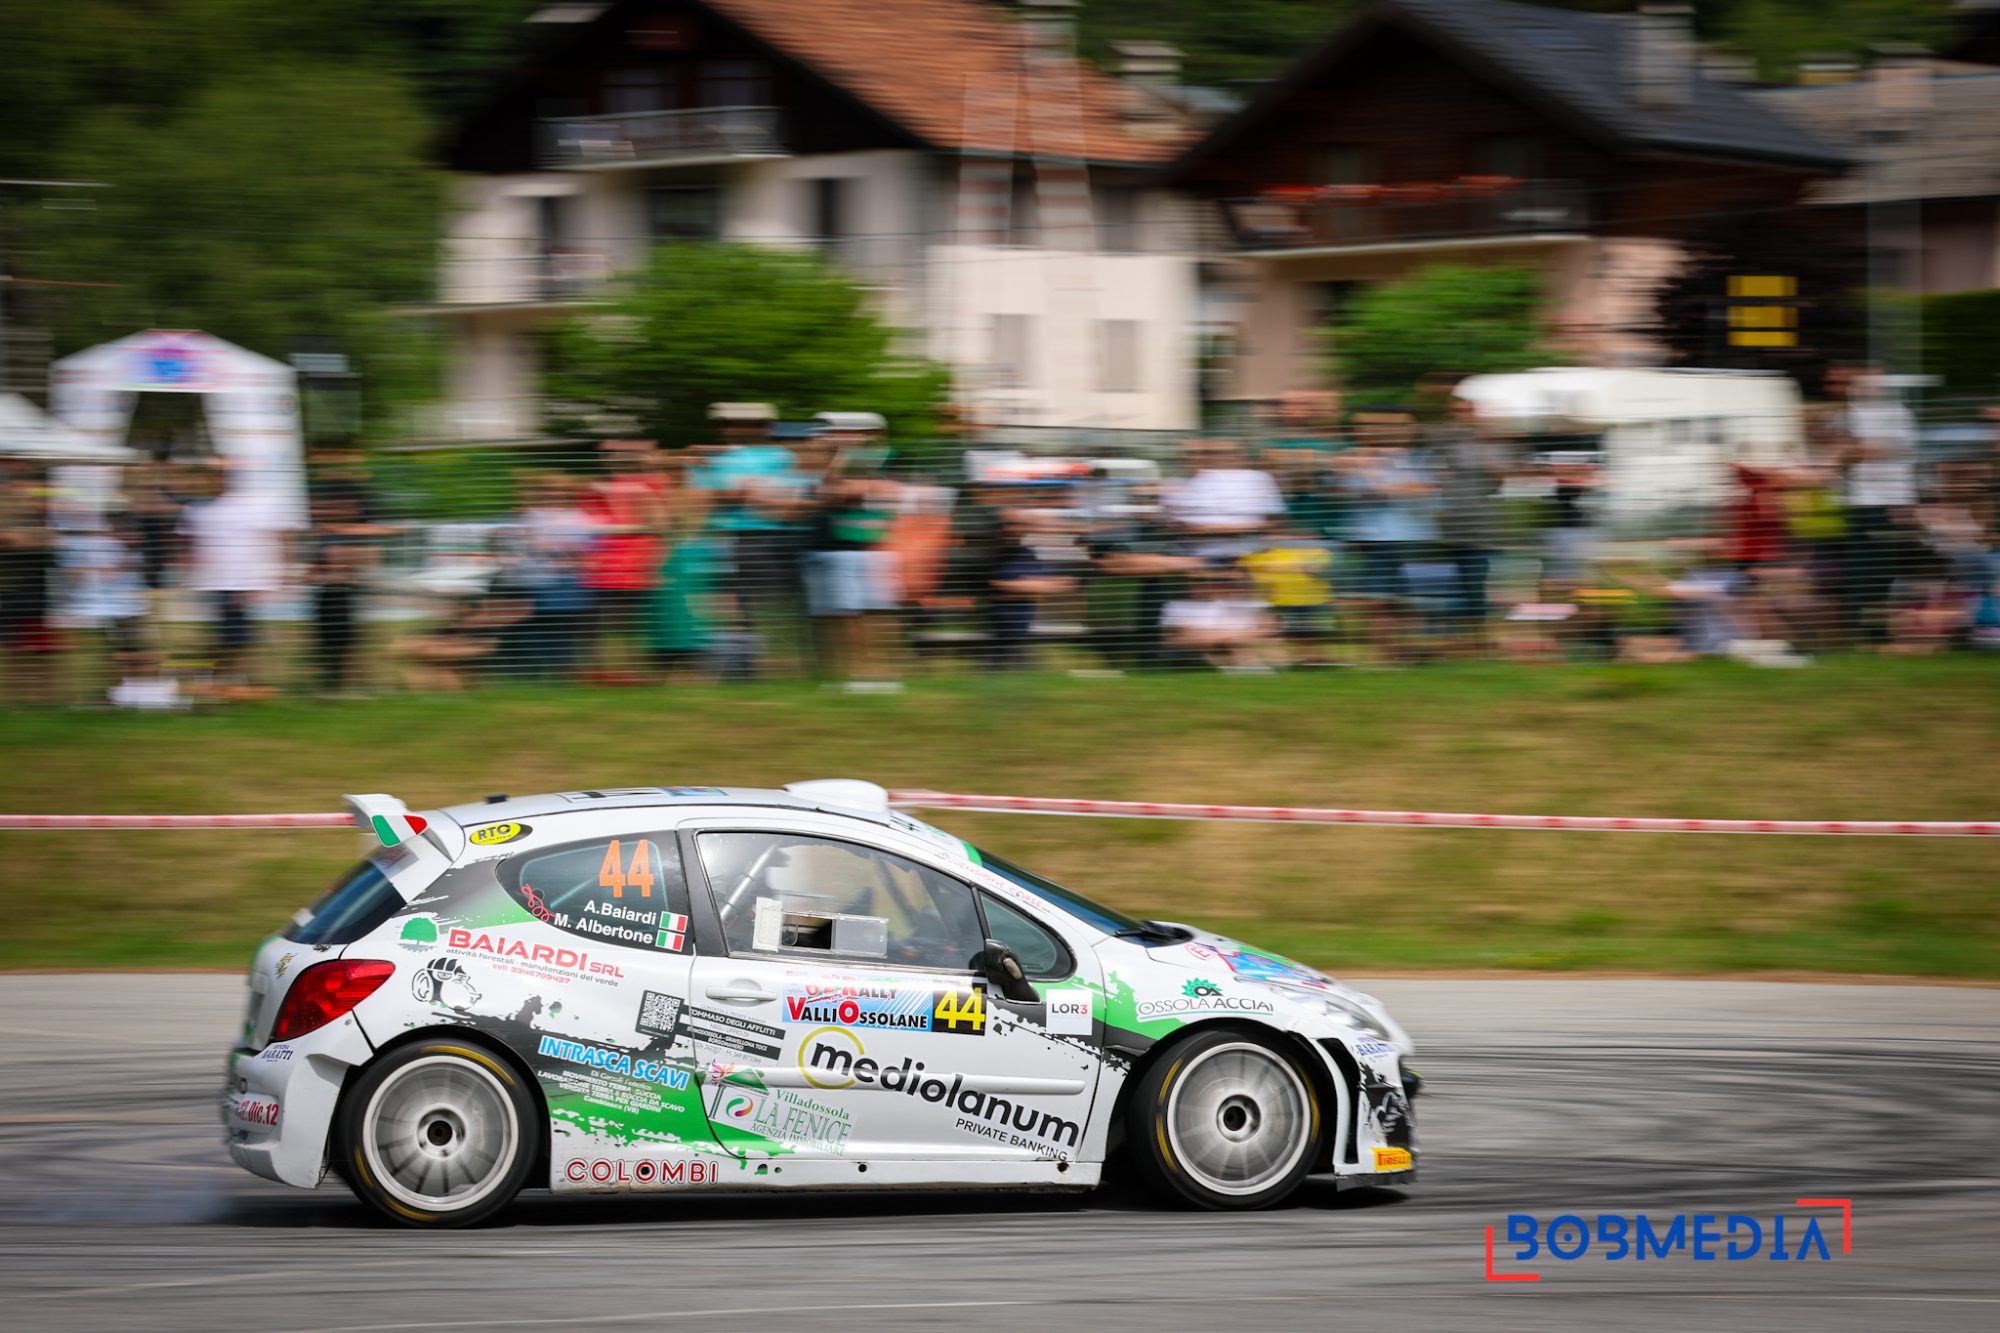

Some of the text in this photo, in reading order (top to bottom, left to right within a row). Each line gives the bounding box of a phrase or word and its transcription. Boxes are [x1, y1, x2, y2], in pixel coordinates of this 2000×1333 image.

[478, 824, 512, 840] RTO
[598, 839, 654, 898] 44
[554, 913, 653, 944] M. Albertone
[446, 948, 619, 987] attività forestali manutenzioni del verde
[448, 928, 624, 978] BAIARDI SRL
[934, 986, 986, 1031] 44
[1051, 1003, 1088, 1015] LOR3
[1139, 998, 1273, 1015] OSSOLA ACCIAI
[726, 1018, 746, 1028] DEGLI
[538, 1035, 690, 1091] INTRASCA SCAVI
[660, 1101, 685, 1113] SCAVO
[775, 1089, 850, 1120] Villadossola
[811, 1042, 1079, 1148] mediolanum
[750, 1123, 787, 1140] AGENZIA
[754, 1096, 852, 1147] LA FENICE
[956, 1118, 1068, 1161] PRIVATE BANKING
[566, 1160, 718, 1183] COLOMBI
